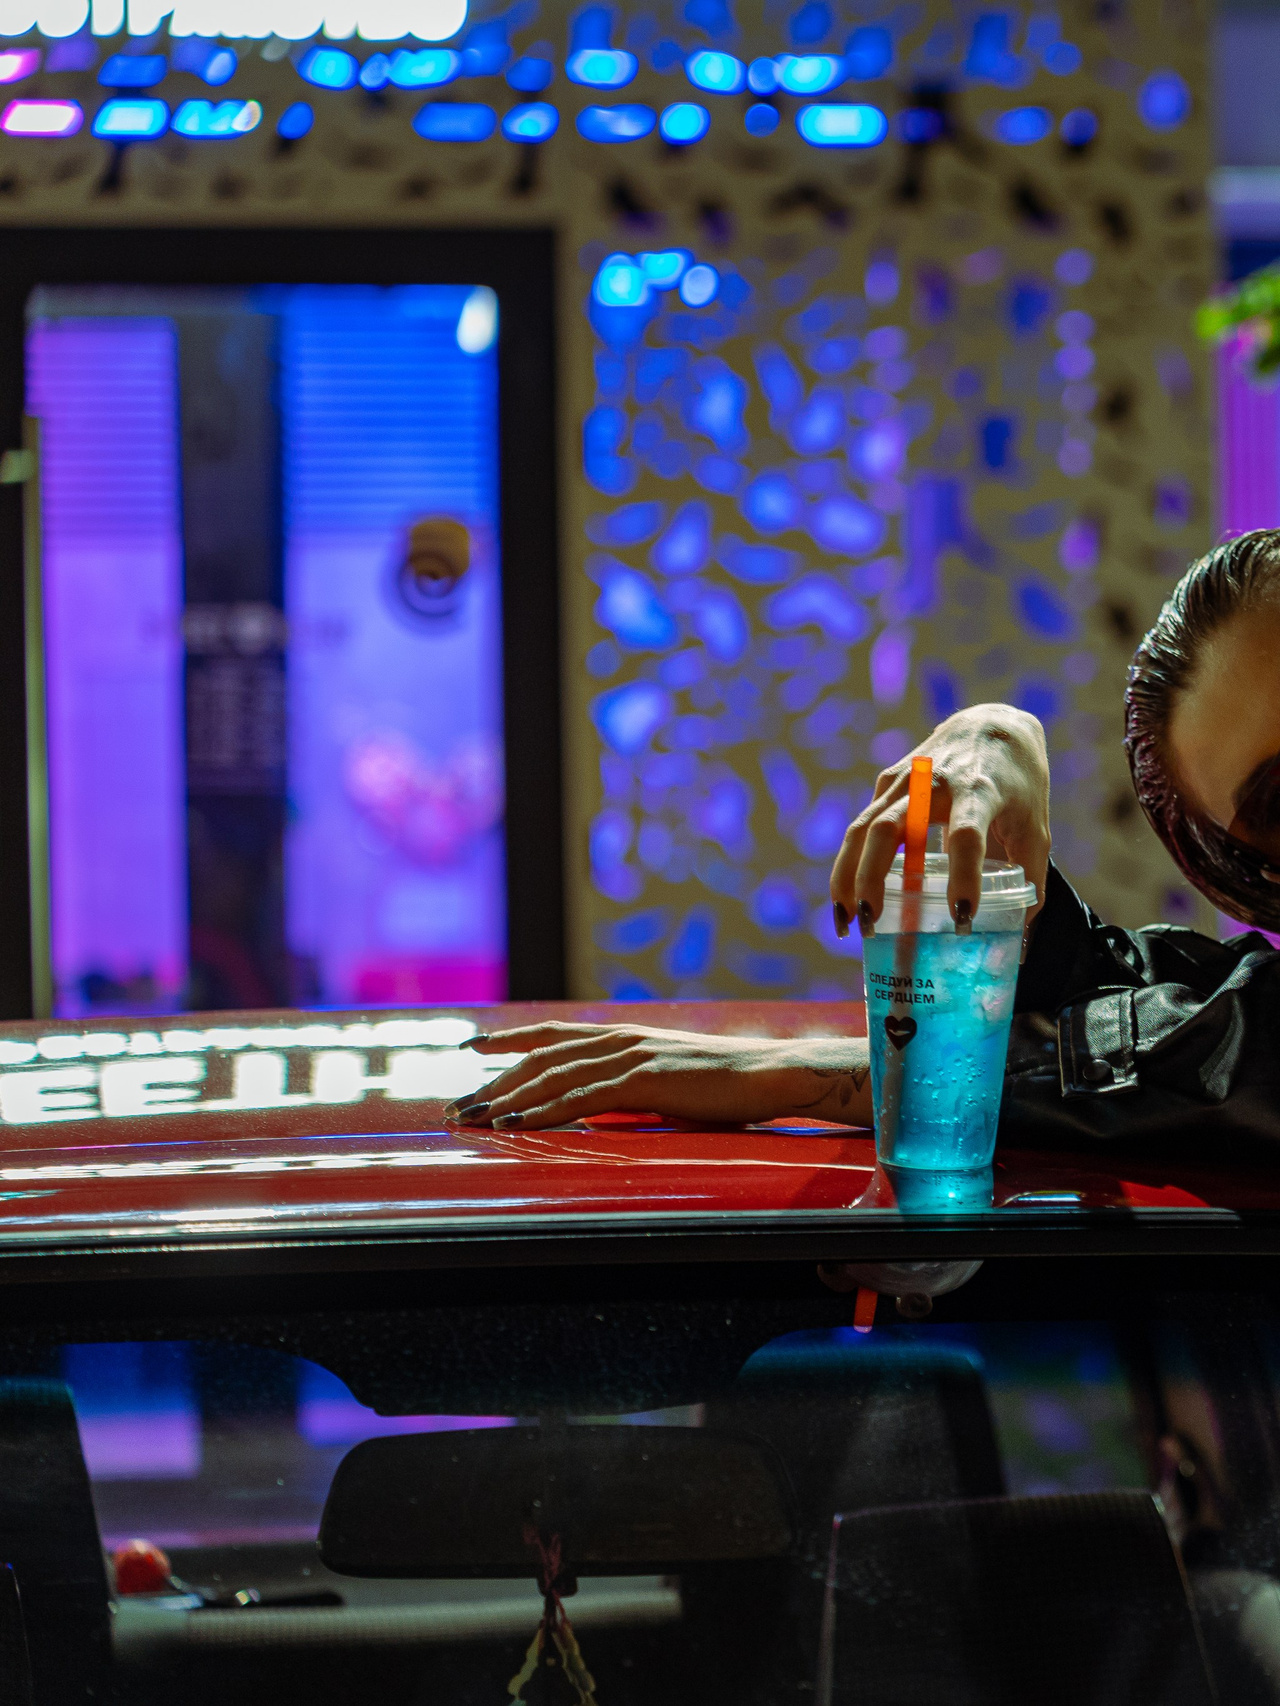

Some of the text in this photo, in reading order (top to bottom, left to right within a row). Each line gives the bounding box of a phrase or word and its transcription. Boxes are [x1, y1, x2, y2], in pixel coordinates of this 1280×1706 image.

[869, 972, 935, 989] СЛЕДУЙ ЗА
[874, 989, 935, 1006] СЕРДЦЕМ
